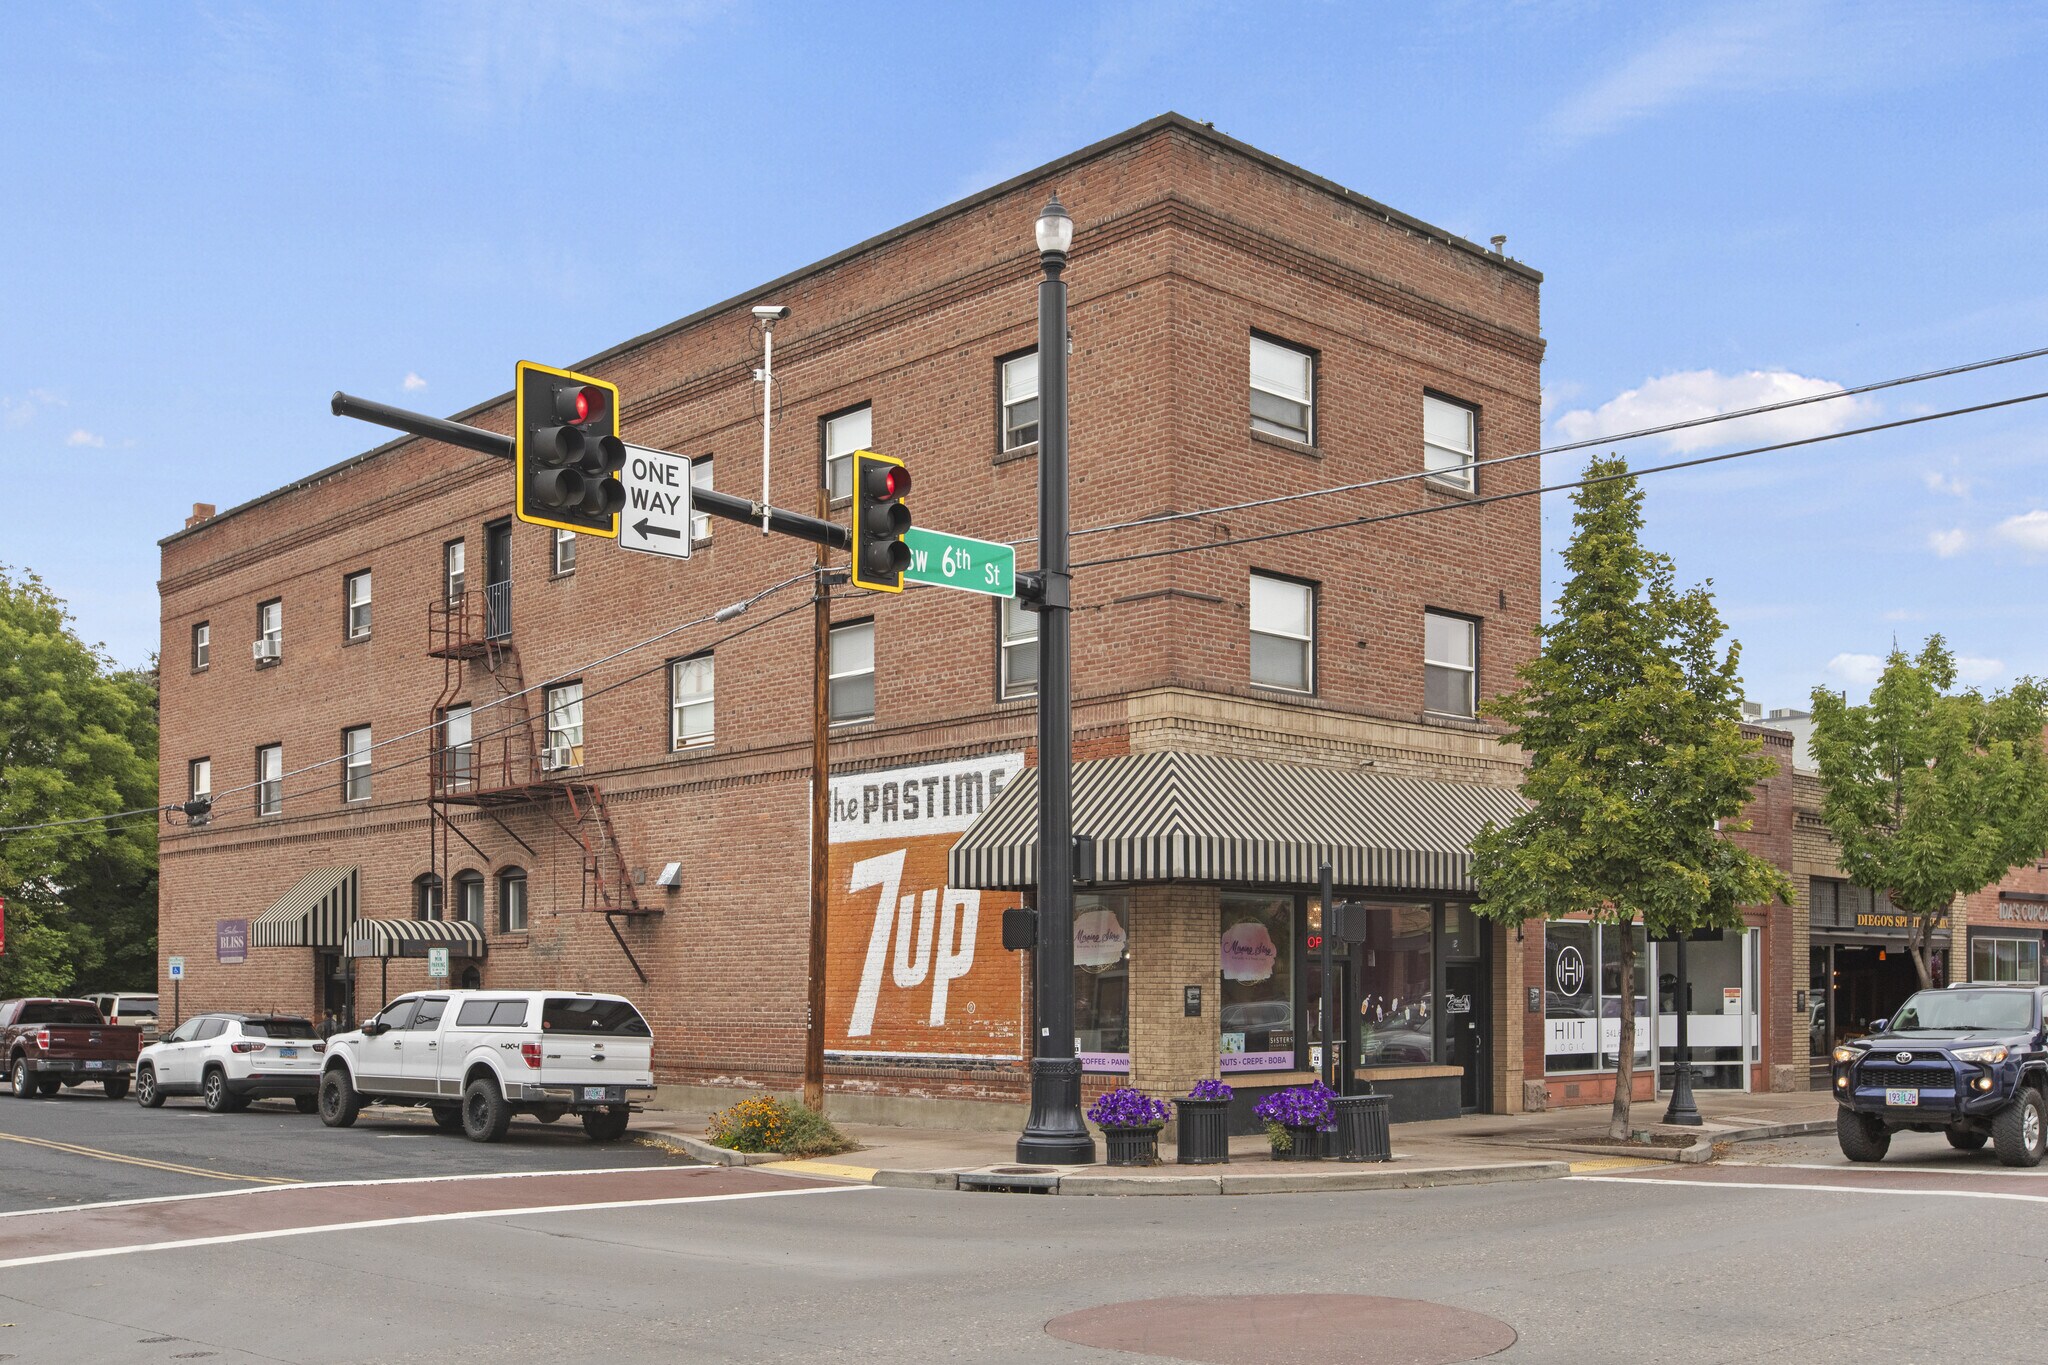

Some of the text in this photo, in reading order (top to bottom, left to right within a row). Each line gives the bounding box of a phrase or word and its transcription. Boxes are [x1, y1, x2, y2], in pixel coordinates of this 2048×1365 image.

[632, 458, 679, 487] ONE
[631, 486, 681, 516] WAY
[942, 545, 971, 578] 6th
[985, 562, 1000, 586] St
[829, 768, 1005, 824] he PASTIME
[1999, 902, 2020, 920] IDA'S
[1857, 914, 1894, 928] DIEGO'S
[1895, 915, 1921, 928] SPIIT
[220, 935, 245, 949] BLISS
[1555, 1021, 1585, 1040] HIIT
[1270, 1036, 1293, 1044] SISTERS
[1554, 1042, 1585, 1052] LOGIC
[1081, 1057, 1106, 1066] COFFEE
[1242, 1057, 1264, 1065] CREPE
[1268, 1056, 1287, 1064] BOBA
